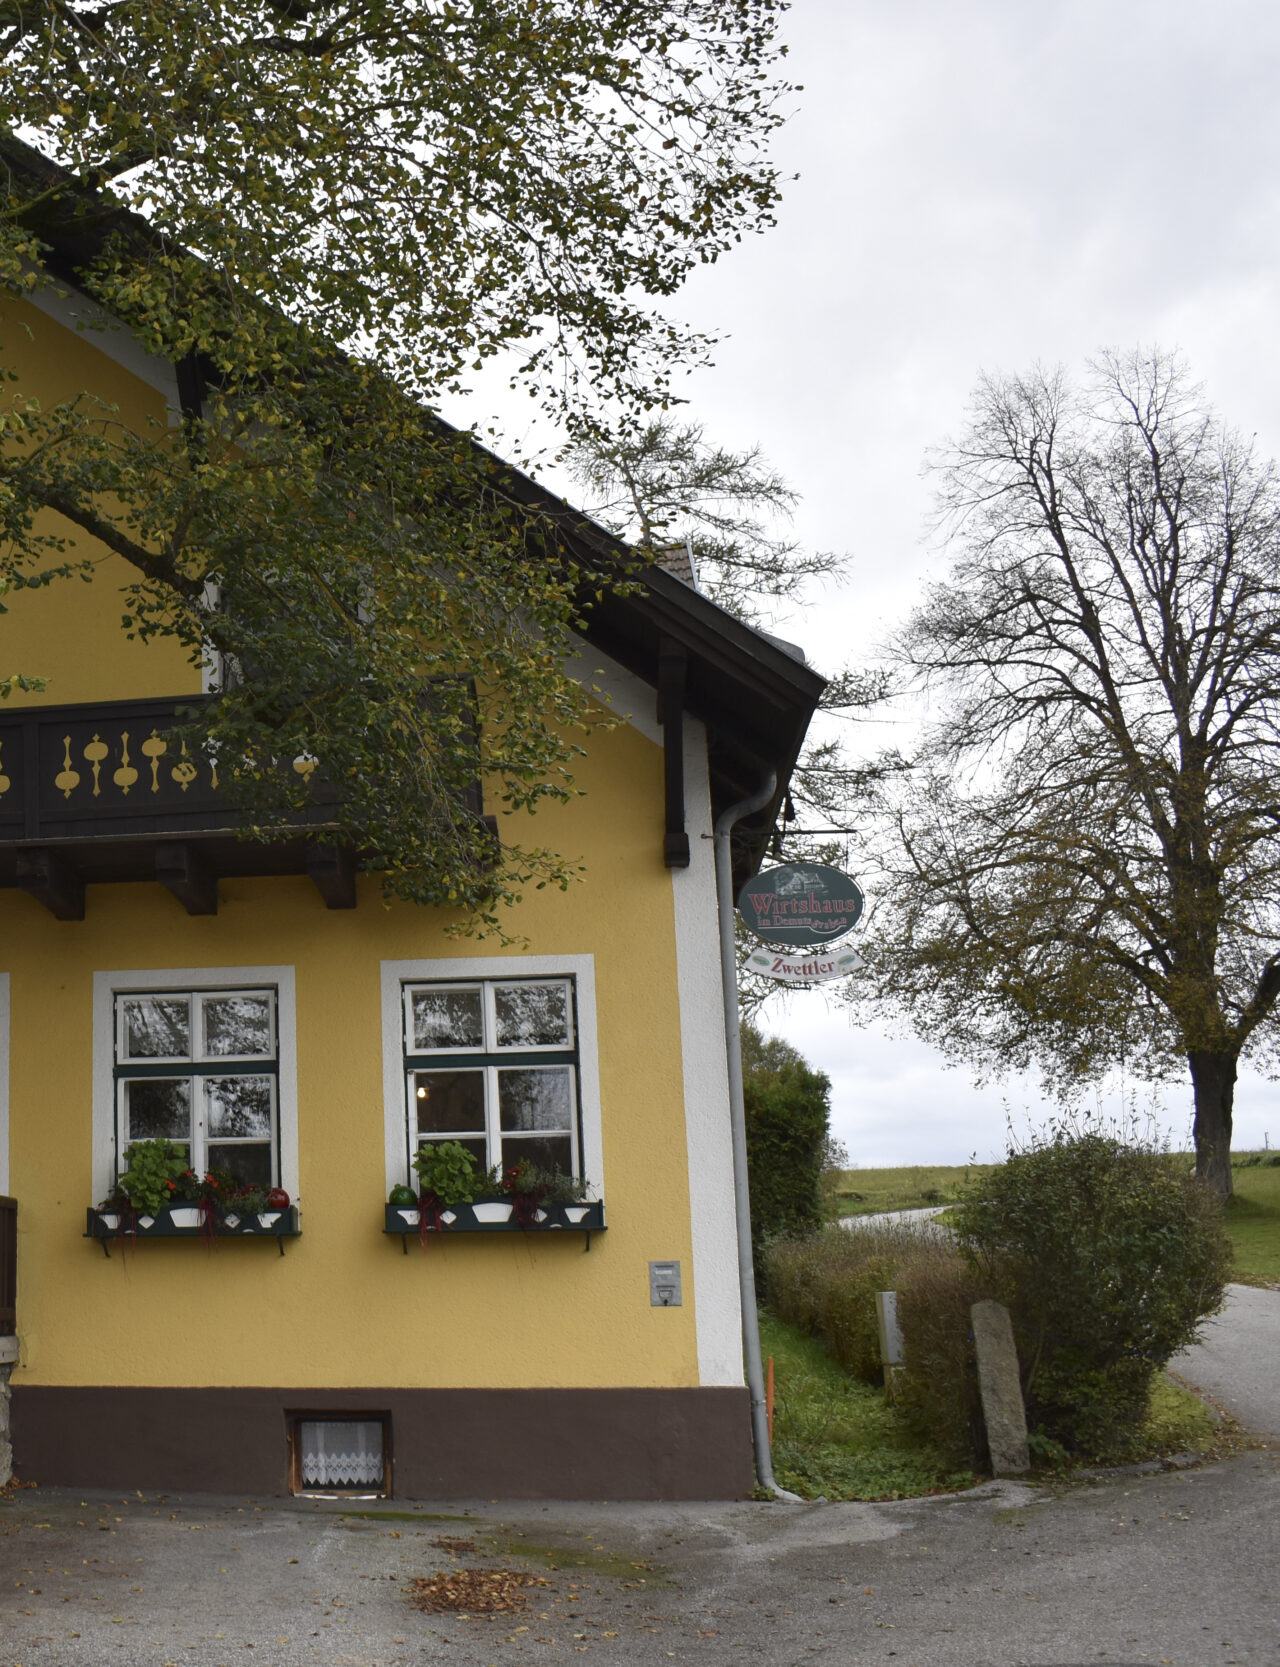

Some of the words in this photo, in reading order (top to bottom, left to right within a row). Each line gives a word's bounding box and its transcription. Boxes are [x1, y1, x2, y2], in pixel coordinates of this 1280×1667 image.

[748, 892, 856, 915] Wirtshaus
[757, 916, 770, 926] im
[771, 957, 835, 975] Zwettler
